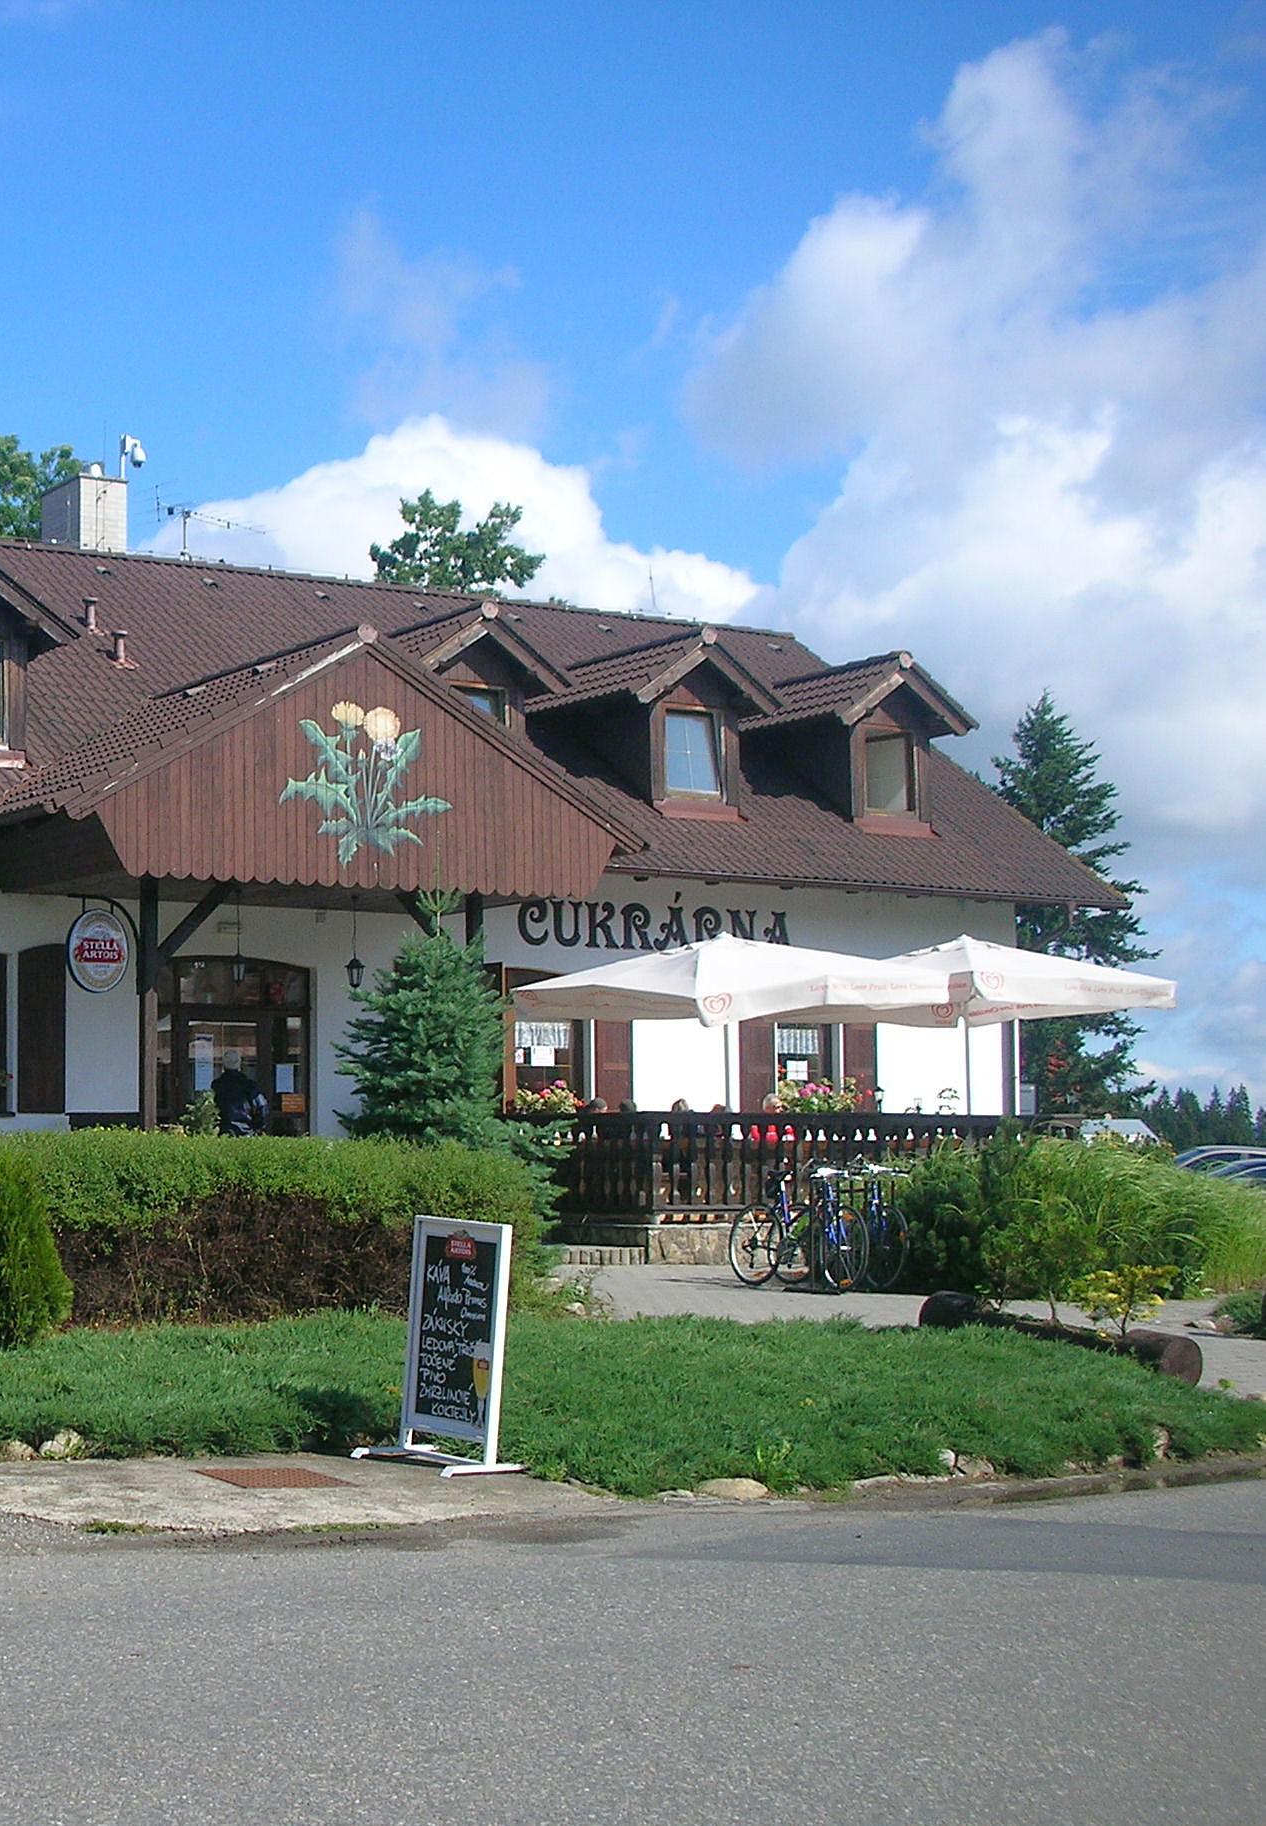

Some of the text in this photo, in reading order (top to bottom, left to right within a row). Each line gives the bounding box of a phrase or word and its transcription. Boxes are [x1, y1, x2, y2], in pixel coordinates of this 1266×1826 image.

[517, 890, 791, 951] CUKRÁRNA
[82, 941, 118, 951] STELLA
[82, 950, 118, 960] ARTOIS
[427, 1258, 451, 1285] KÁVA
[419, 1368, 447, 1384] PIVO
